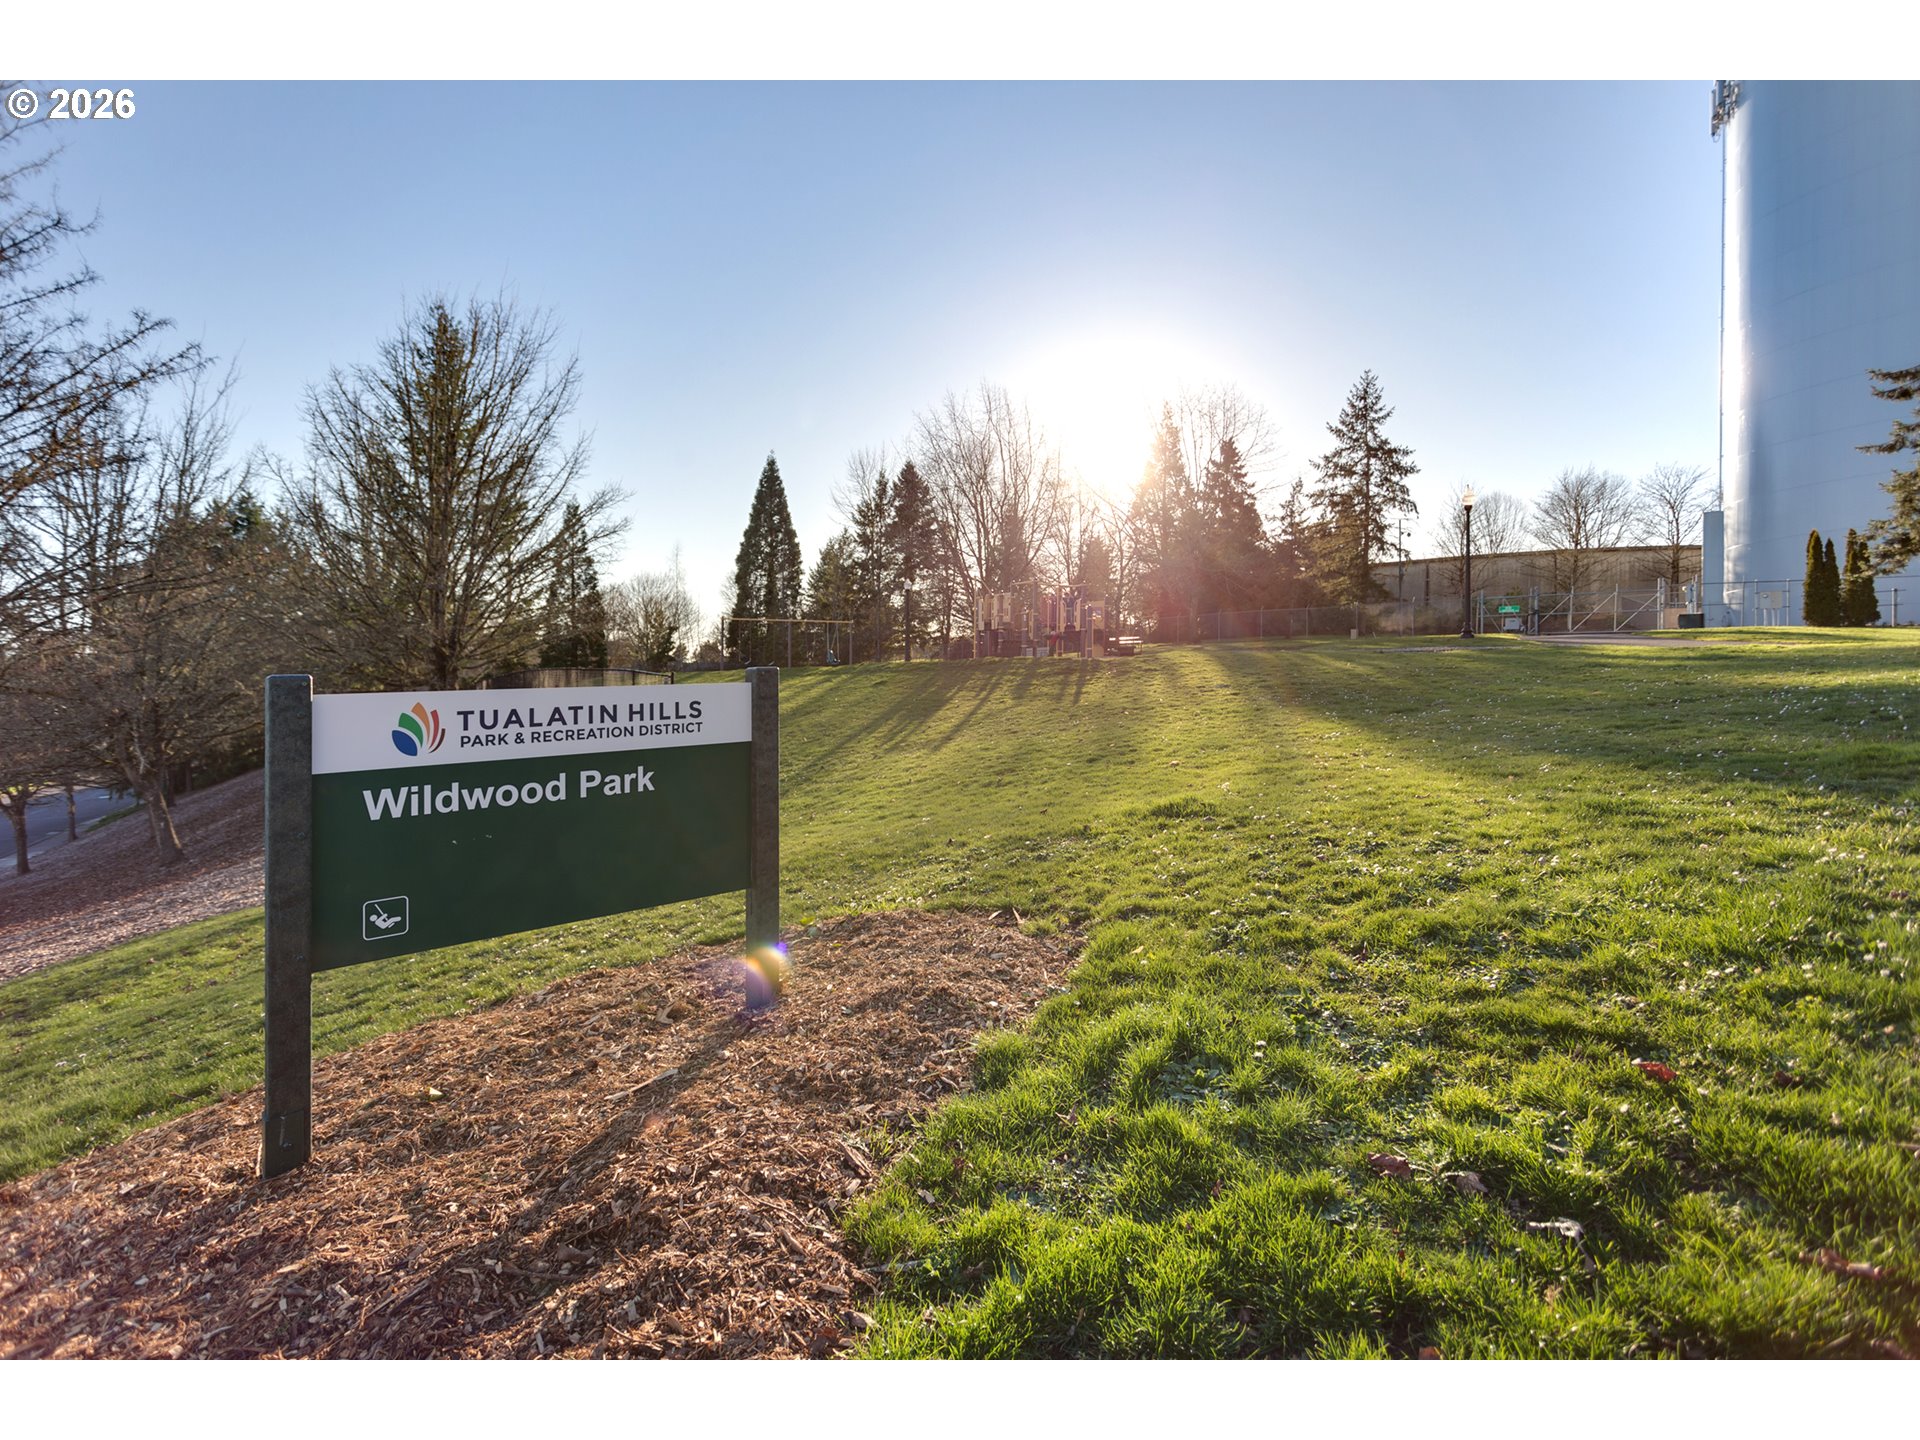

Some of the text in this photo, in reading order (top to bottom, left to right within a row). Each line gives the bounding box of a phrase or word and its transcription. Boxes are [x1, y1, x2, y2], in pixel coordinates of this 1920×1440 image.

[457, 700, 702, 731] TUALATIN HILLS
[460, 721, 703, 748] PARK & RECREATION DISTRICT
[363, 765, 655, 821] Wildwood Park
